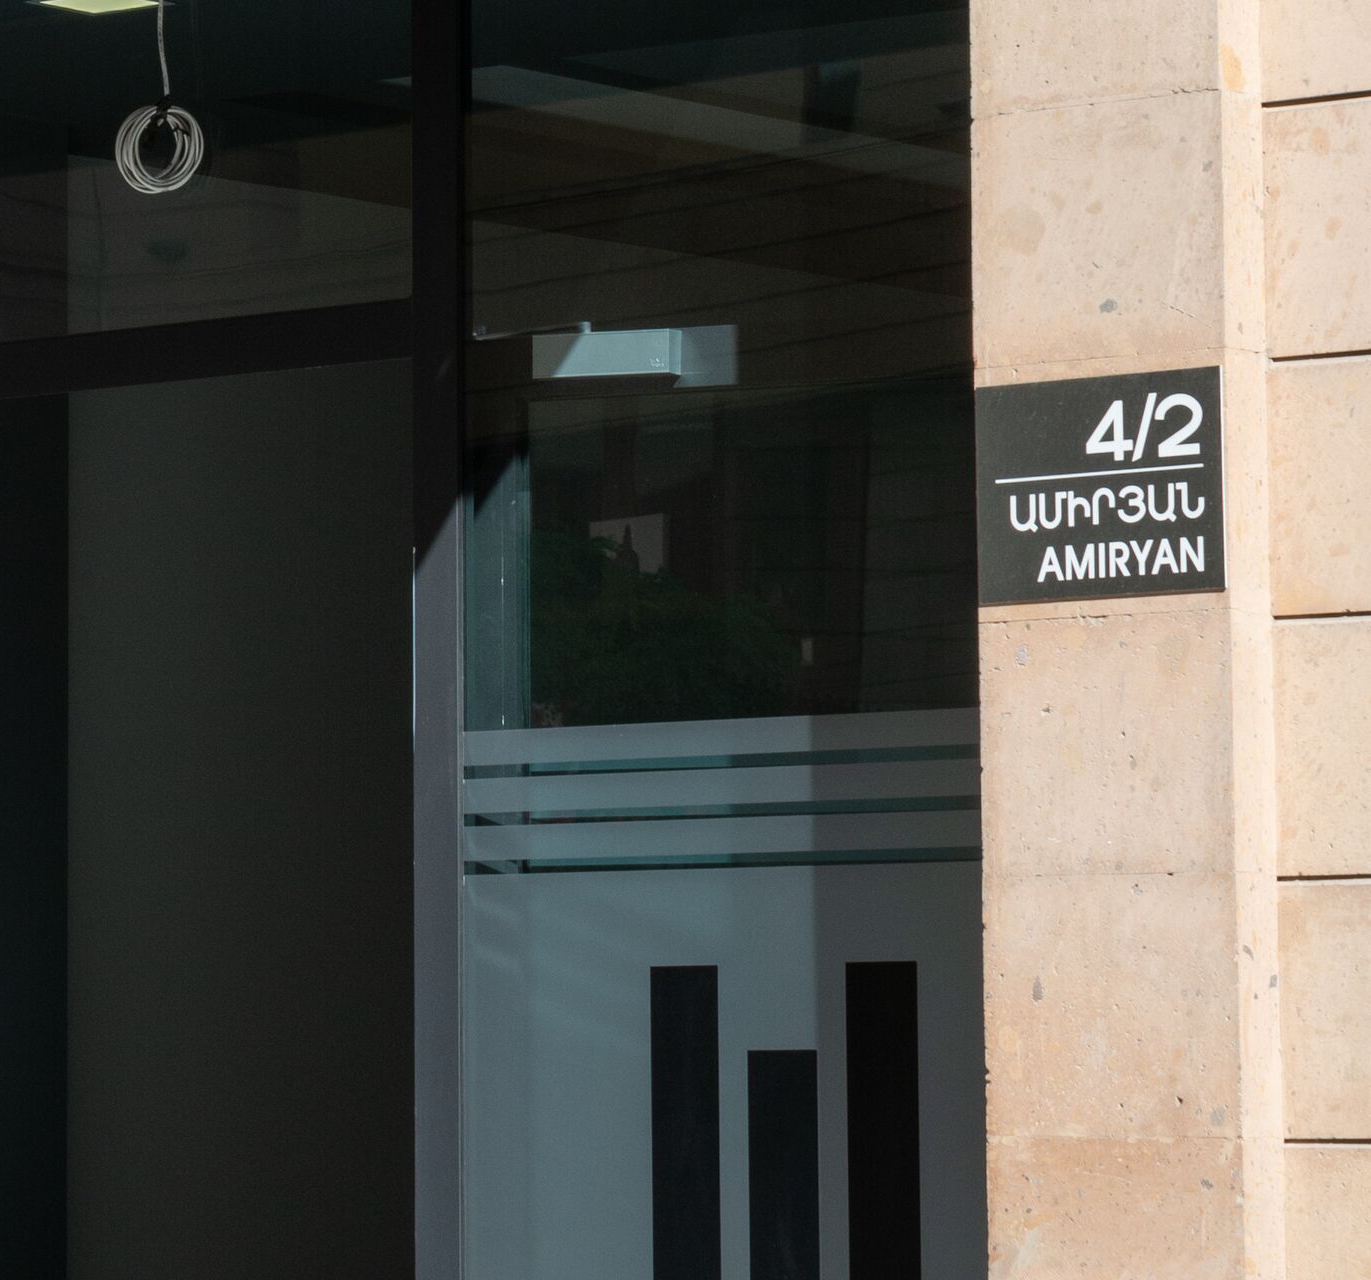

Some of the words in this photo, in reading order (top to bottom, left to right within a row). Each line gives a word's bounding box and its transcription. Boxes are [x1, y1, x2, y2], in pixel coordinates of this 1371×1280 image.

[1084, 391, 1204, 463] 4/2
[1008, 481, 1206, 534] ԱՄԻՐՅԱՆ
[1036, 535, 1206, 584] AMIRYAN
